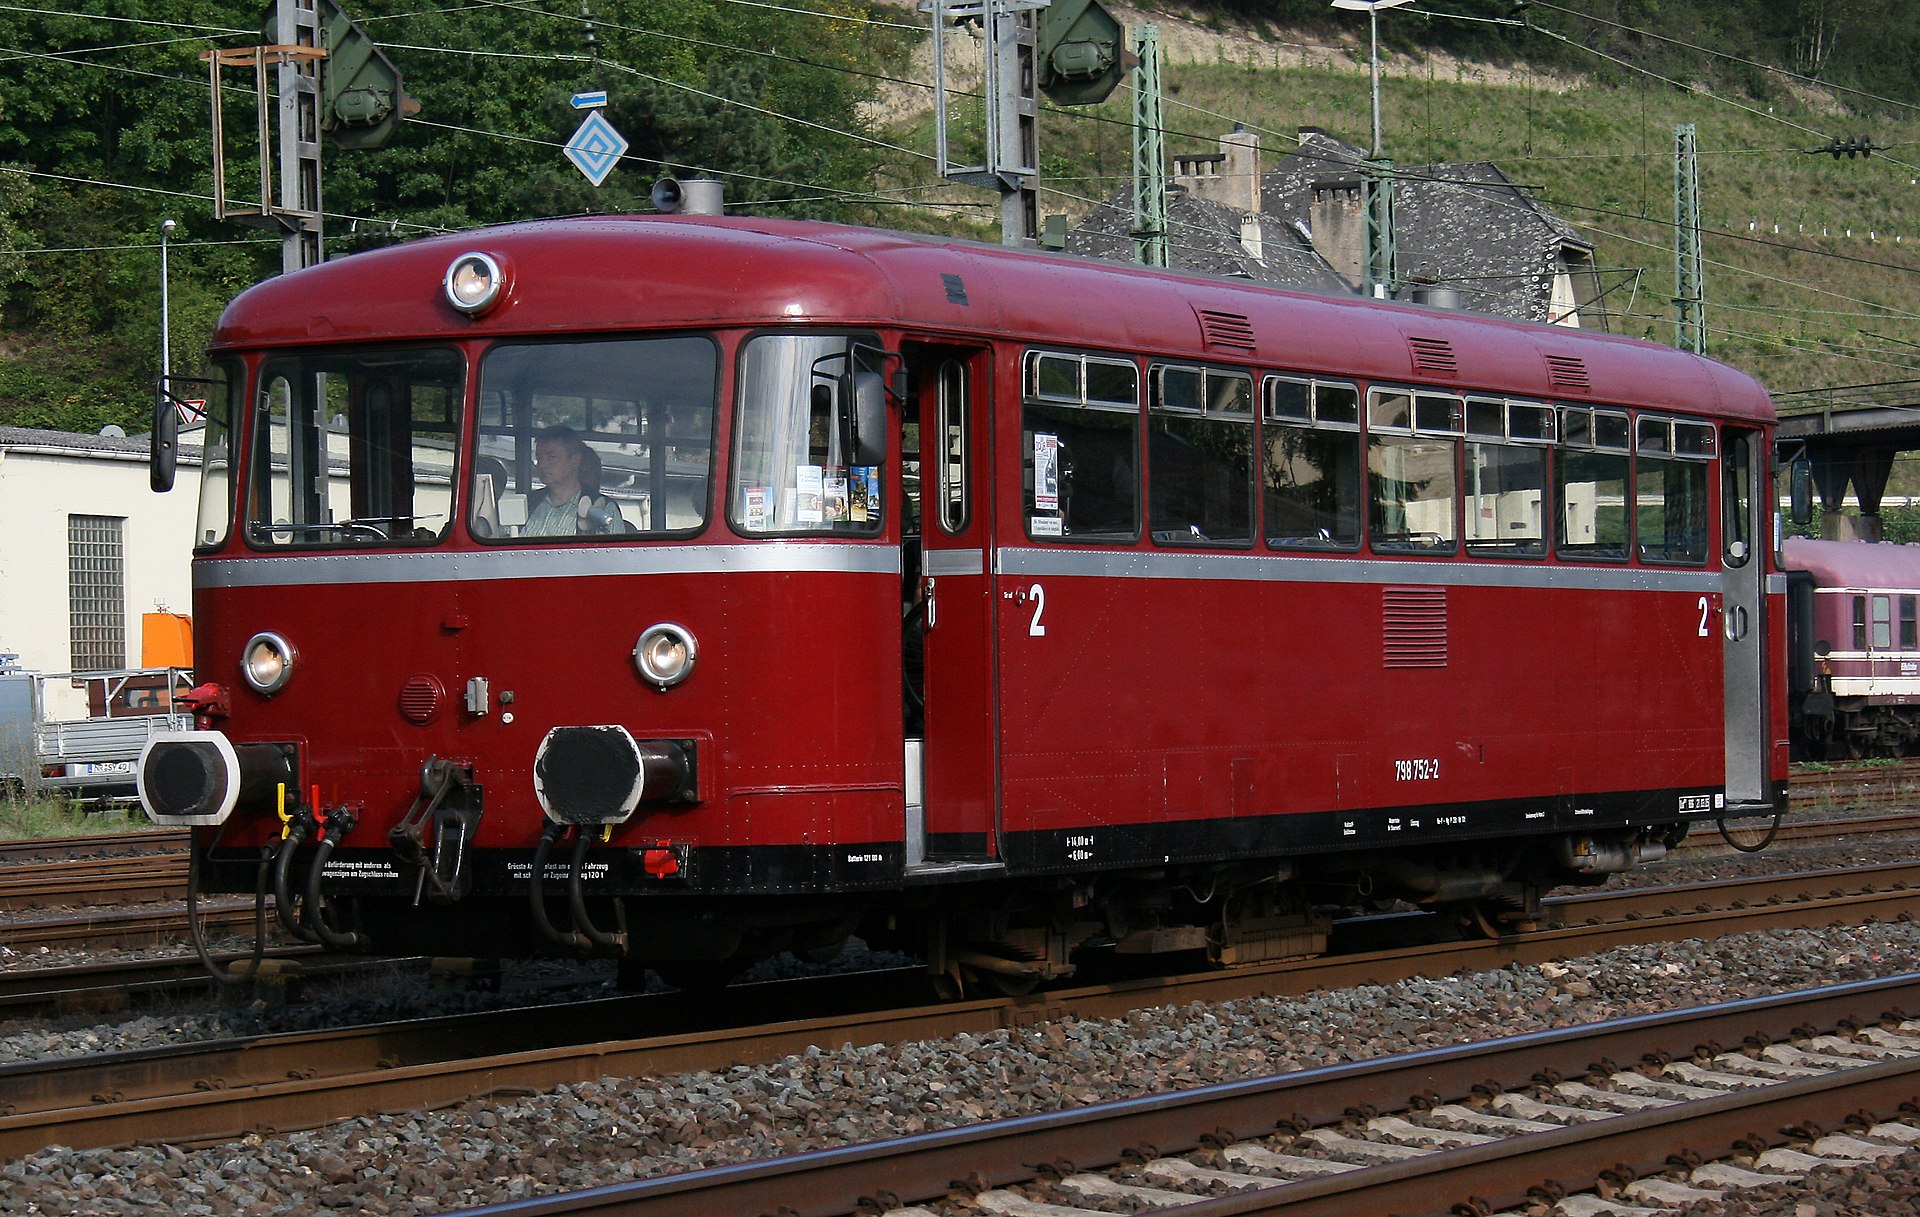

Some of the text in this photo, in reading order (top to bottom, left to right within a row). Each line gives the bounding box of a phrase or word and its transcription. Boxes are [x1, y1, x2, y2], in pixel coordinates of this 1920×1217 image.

[1028, 583, 1045, 636] 2
[1697, 596, 1709, 637] 2
[1394, 758, 1440, 781] 798 752-2
[328, 861, 354, 870] Beförderung
[355, 861, 363, 869] mit
[507, 862, 526, 870] Grösste
[584, 862, 609, 872] Fahrzeug
[358, 870, 383, 879] Zugschluss
[383, 870, 399, 878] reihen
[513, 871, 522, 879] mit
[588, 871, 600, 879] 120
